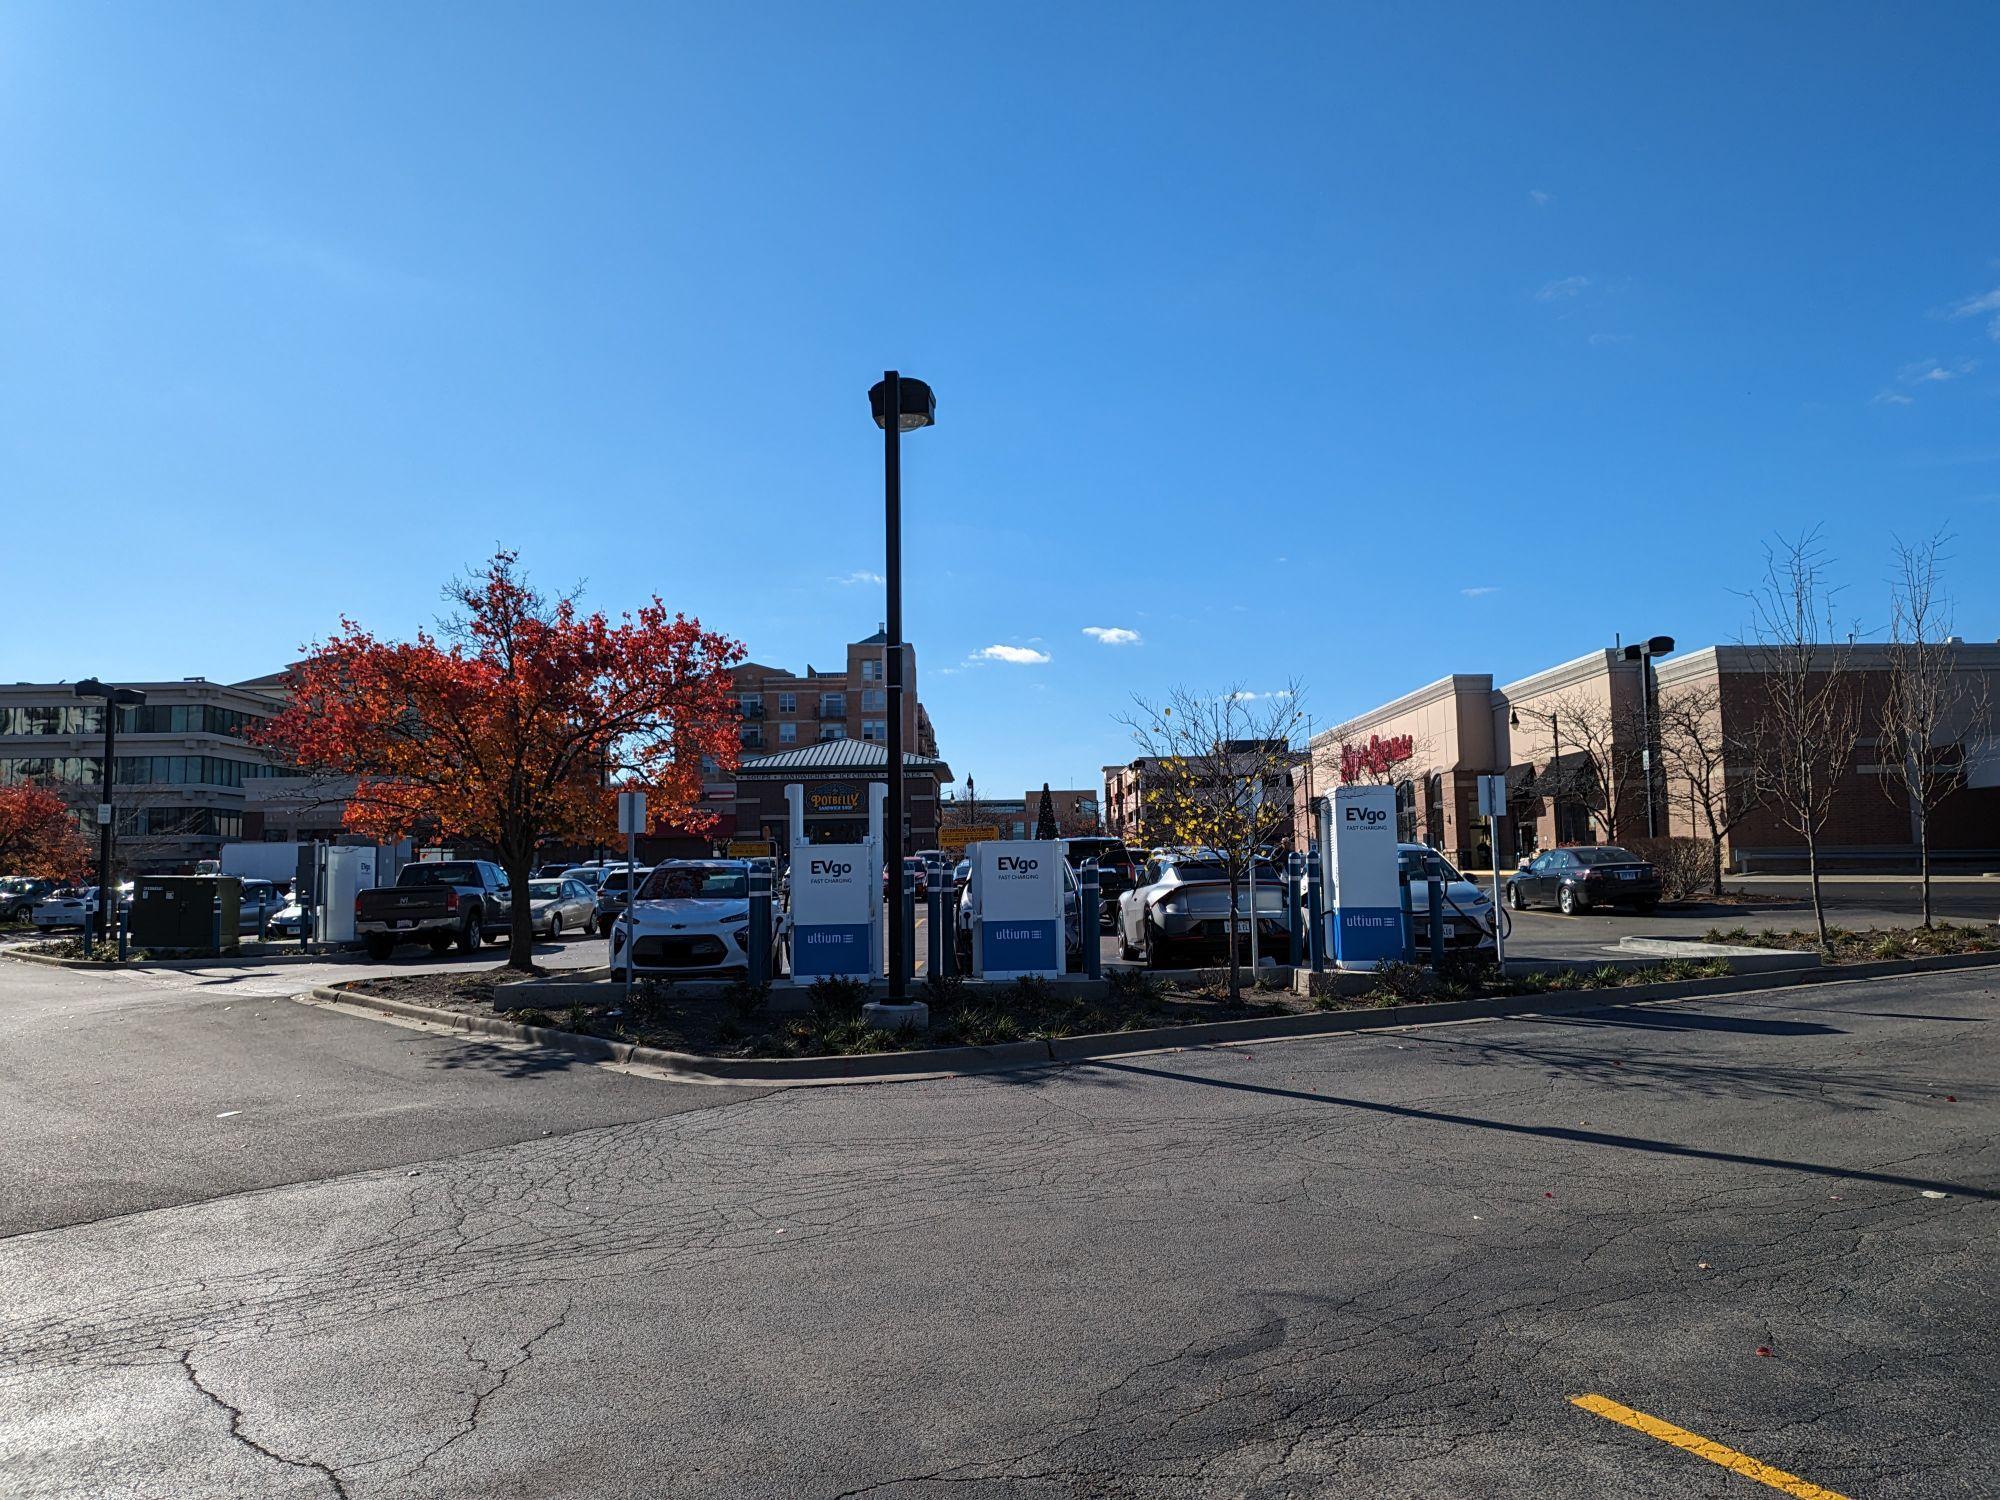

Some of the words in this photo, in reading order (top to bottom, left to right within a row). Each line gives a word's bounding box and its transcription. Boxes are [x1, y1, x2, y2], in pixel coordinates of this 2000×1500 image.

[810, 792, 860, 807] POTBELLY
[1345, 807, 1387, 825] EVgo
[810, 860, 852, 877] EVgo
[997, 856, 1039, 874] EVgo
[1346, 915, 1382, 927] ultium
[807, 932, 842, 944] ultium
[996, 928, 1030, 940] ultium
